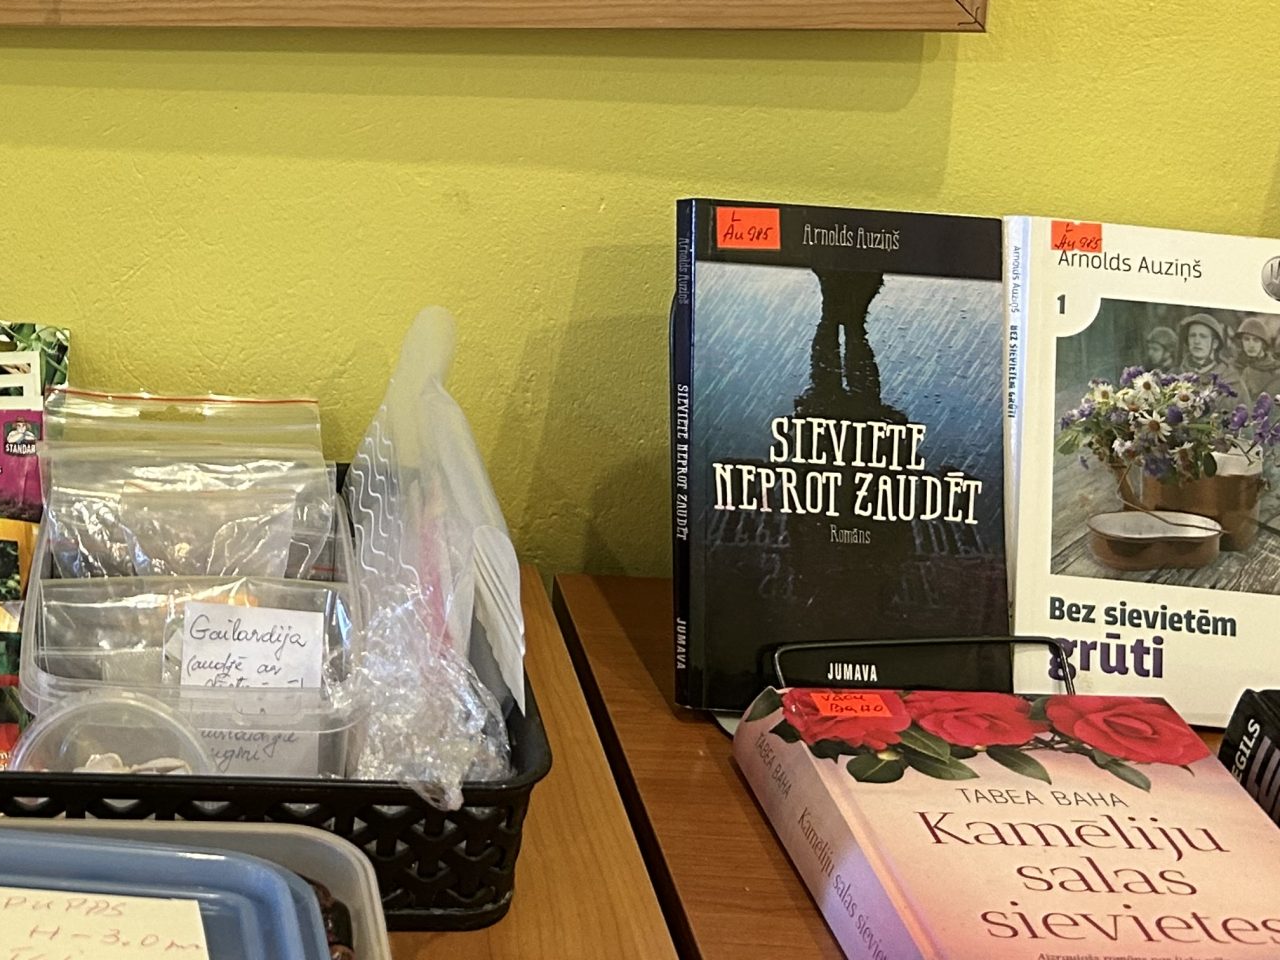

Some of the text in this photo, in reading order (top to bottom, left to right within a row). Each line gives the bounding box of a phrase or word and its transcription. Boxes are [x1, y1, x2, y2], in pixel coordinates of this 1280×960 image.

[731, 211, 741, 222] L
[747, 226, 773, 241] 985
[802, 223, 900, 252] Arnolds Auziņš
[1058, 250, 1203, 282] Arnolds Auziņš
[1057, 294, 1066, 315] 1
[676, 384, 689, 439] SIEVIETE
[5, 443, 36, 455] STANDAR
[770, 415, 926, 470] SIEVIETE
[676, 444, 689, 490] NEPROT
[712, 463, 983, 525] NEPROT ZAUDĒT
[830, 523, 871, 545] Romāns
[1049, 596, 1238, 638] Bez sievietēm
[676, 617, 687, 670] JUMAVA
[1048, 636, 1165, 681] grūti
[827, 662, 878, 682] JUMAVA
[754, 732, 792, 800] TABEA BAHA
[1231, 719, 1261, 782] EGILS
[955, 788, 1129, 808] TABEA BAHA
[913, 810, 1231, 862] Kamēliju
[1016, 857, 1198, 897] salas
[832, 873, 858, 918] salas
[857, 915, 891, 960] sievie
[980, 902, 1280, 946] sievietes
